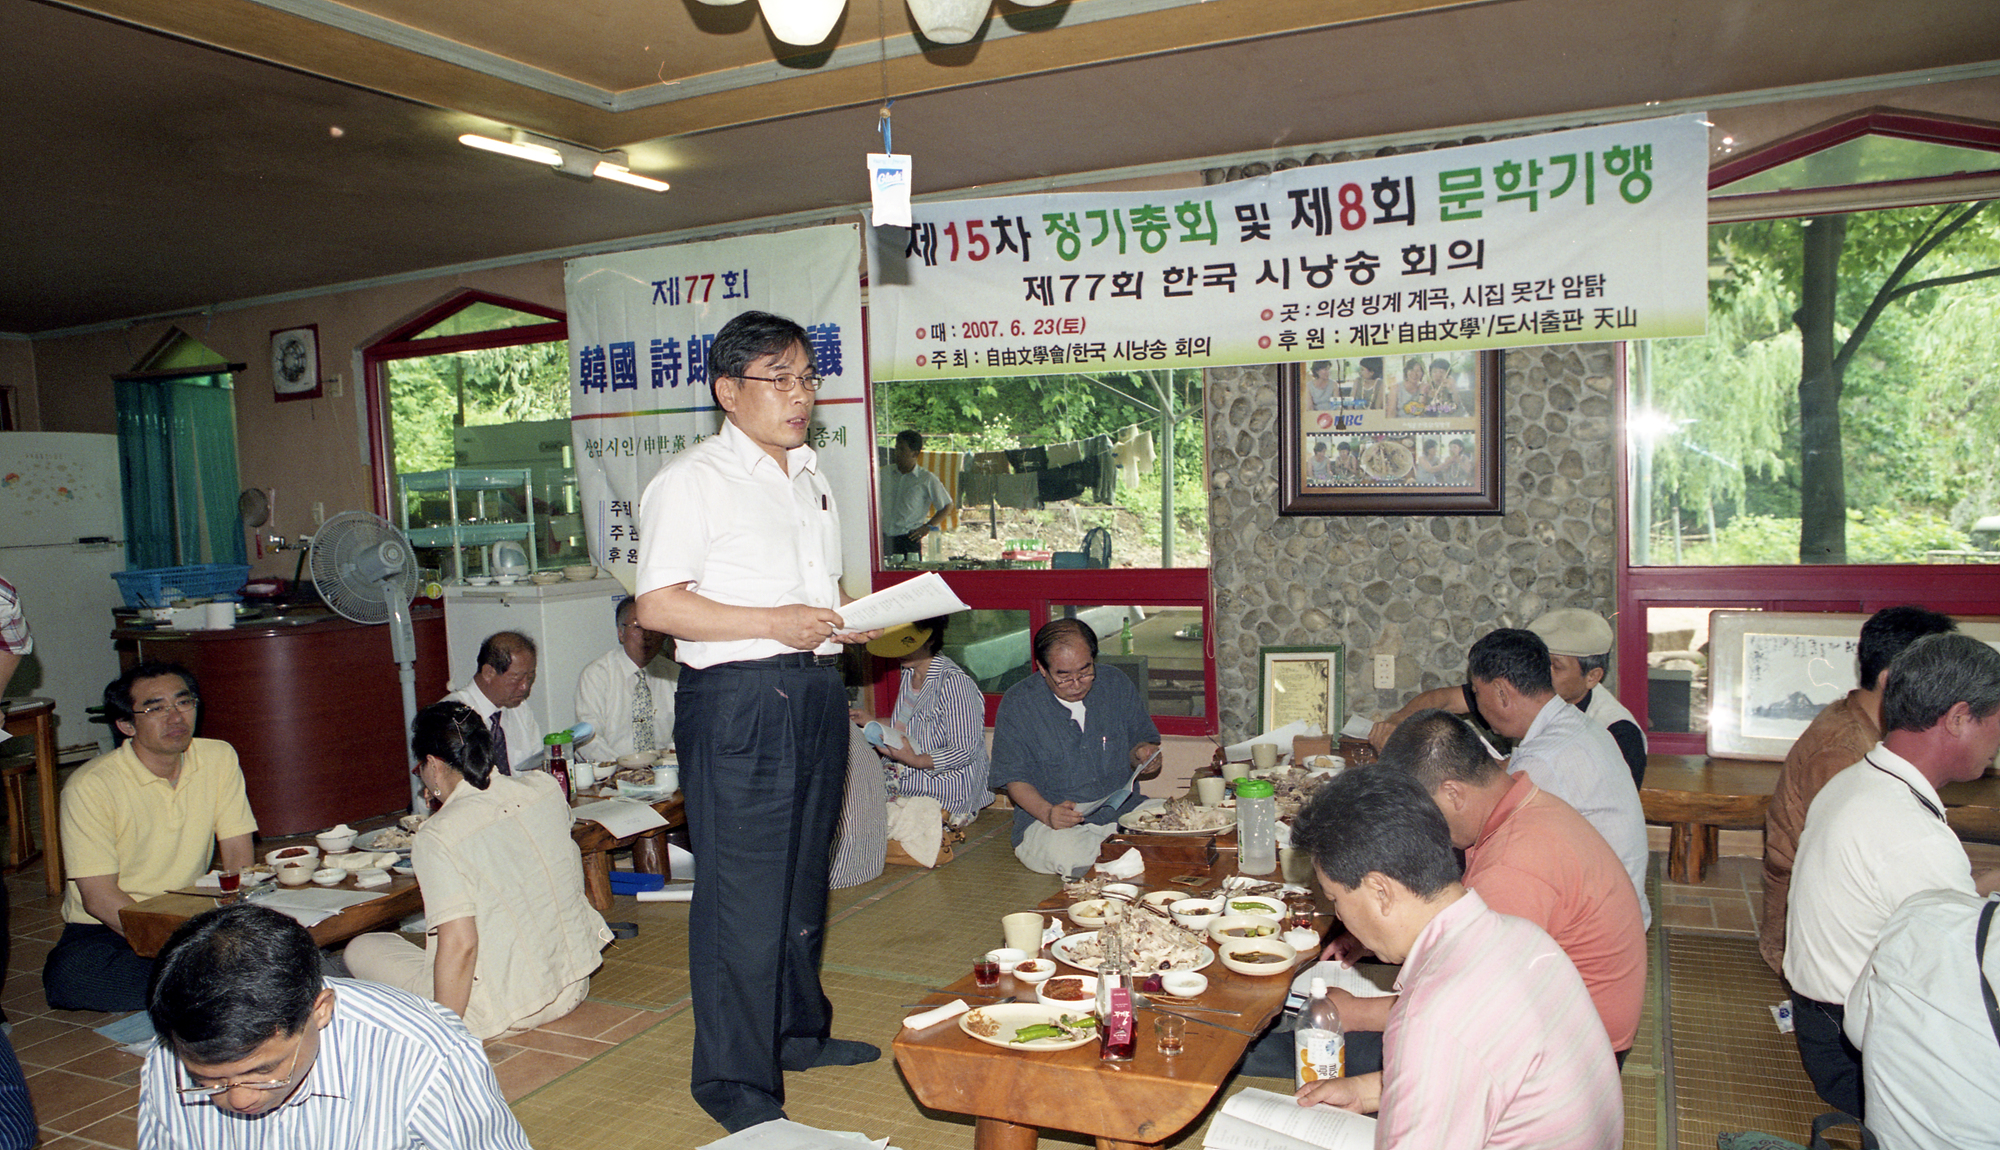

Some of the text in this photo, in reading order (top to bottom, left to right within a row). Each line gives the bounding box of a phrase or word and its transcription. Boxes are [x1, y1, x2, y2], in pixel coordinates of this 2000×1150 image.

[906, 144, 1653, 267] 제15차 정기총회 및 제8회 문학기행
[652, 269, 748, 306] 제77회
[1023, 239, 1485, 306] 제77회 한국 시낭송 회의
[1317, 297, 1355, 318] 의성
[1361, 292, 1400, 315] 빙계
[1407, 288, 1455, 311] 계곡,
[1462, 283, 1505, 306] 시집
[1511, 279, 1555, 302] 못간
[1561, 274, 1606, 298] 암탉
[1033, 316, 1086, 336] 23(토)
[1594, 306, 1637, 329] 天山
[1113, 339, 1167, 361] 시낭송
[1175, 336, 1211, 358] 회의
